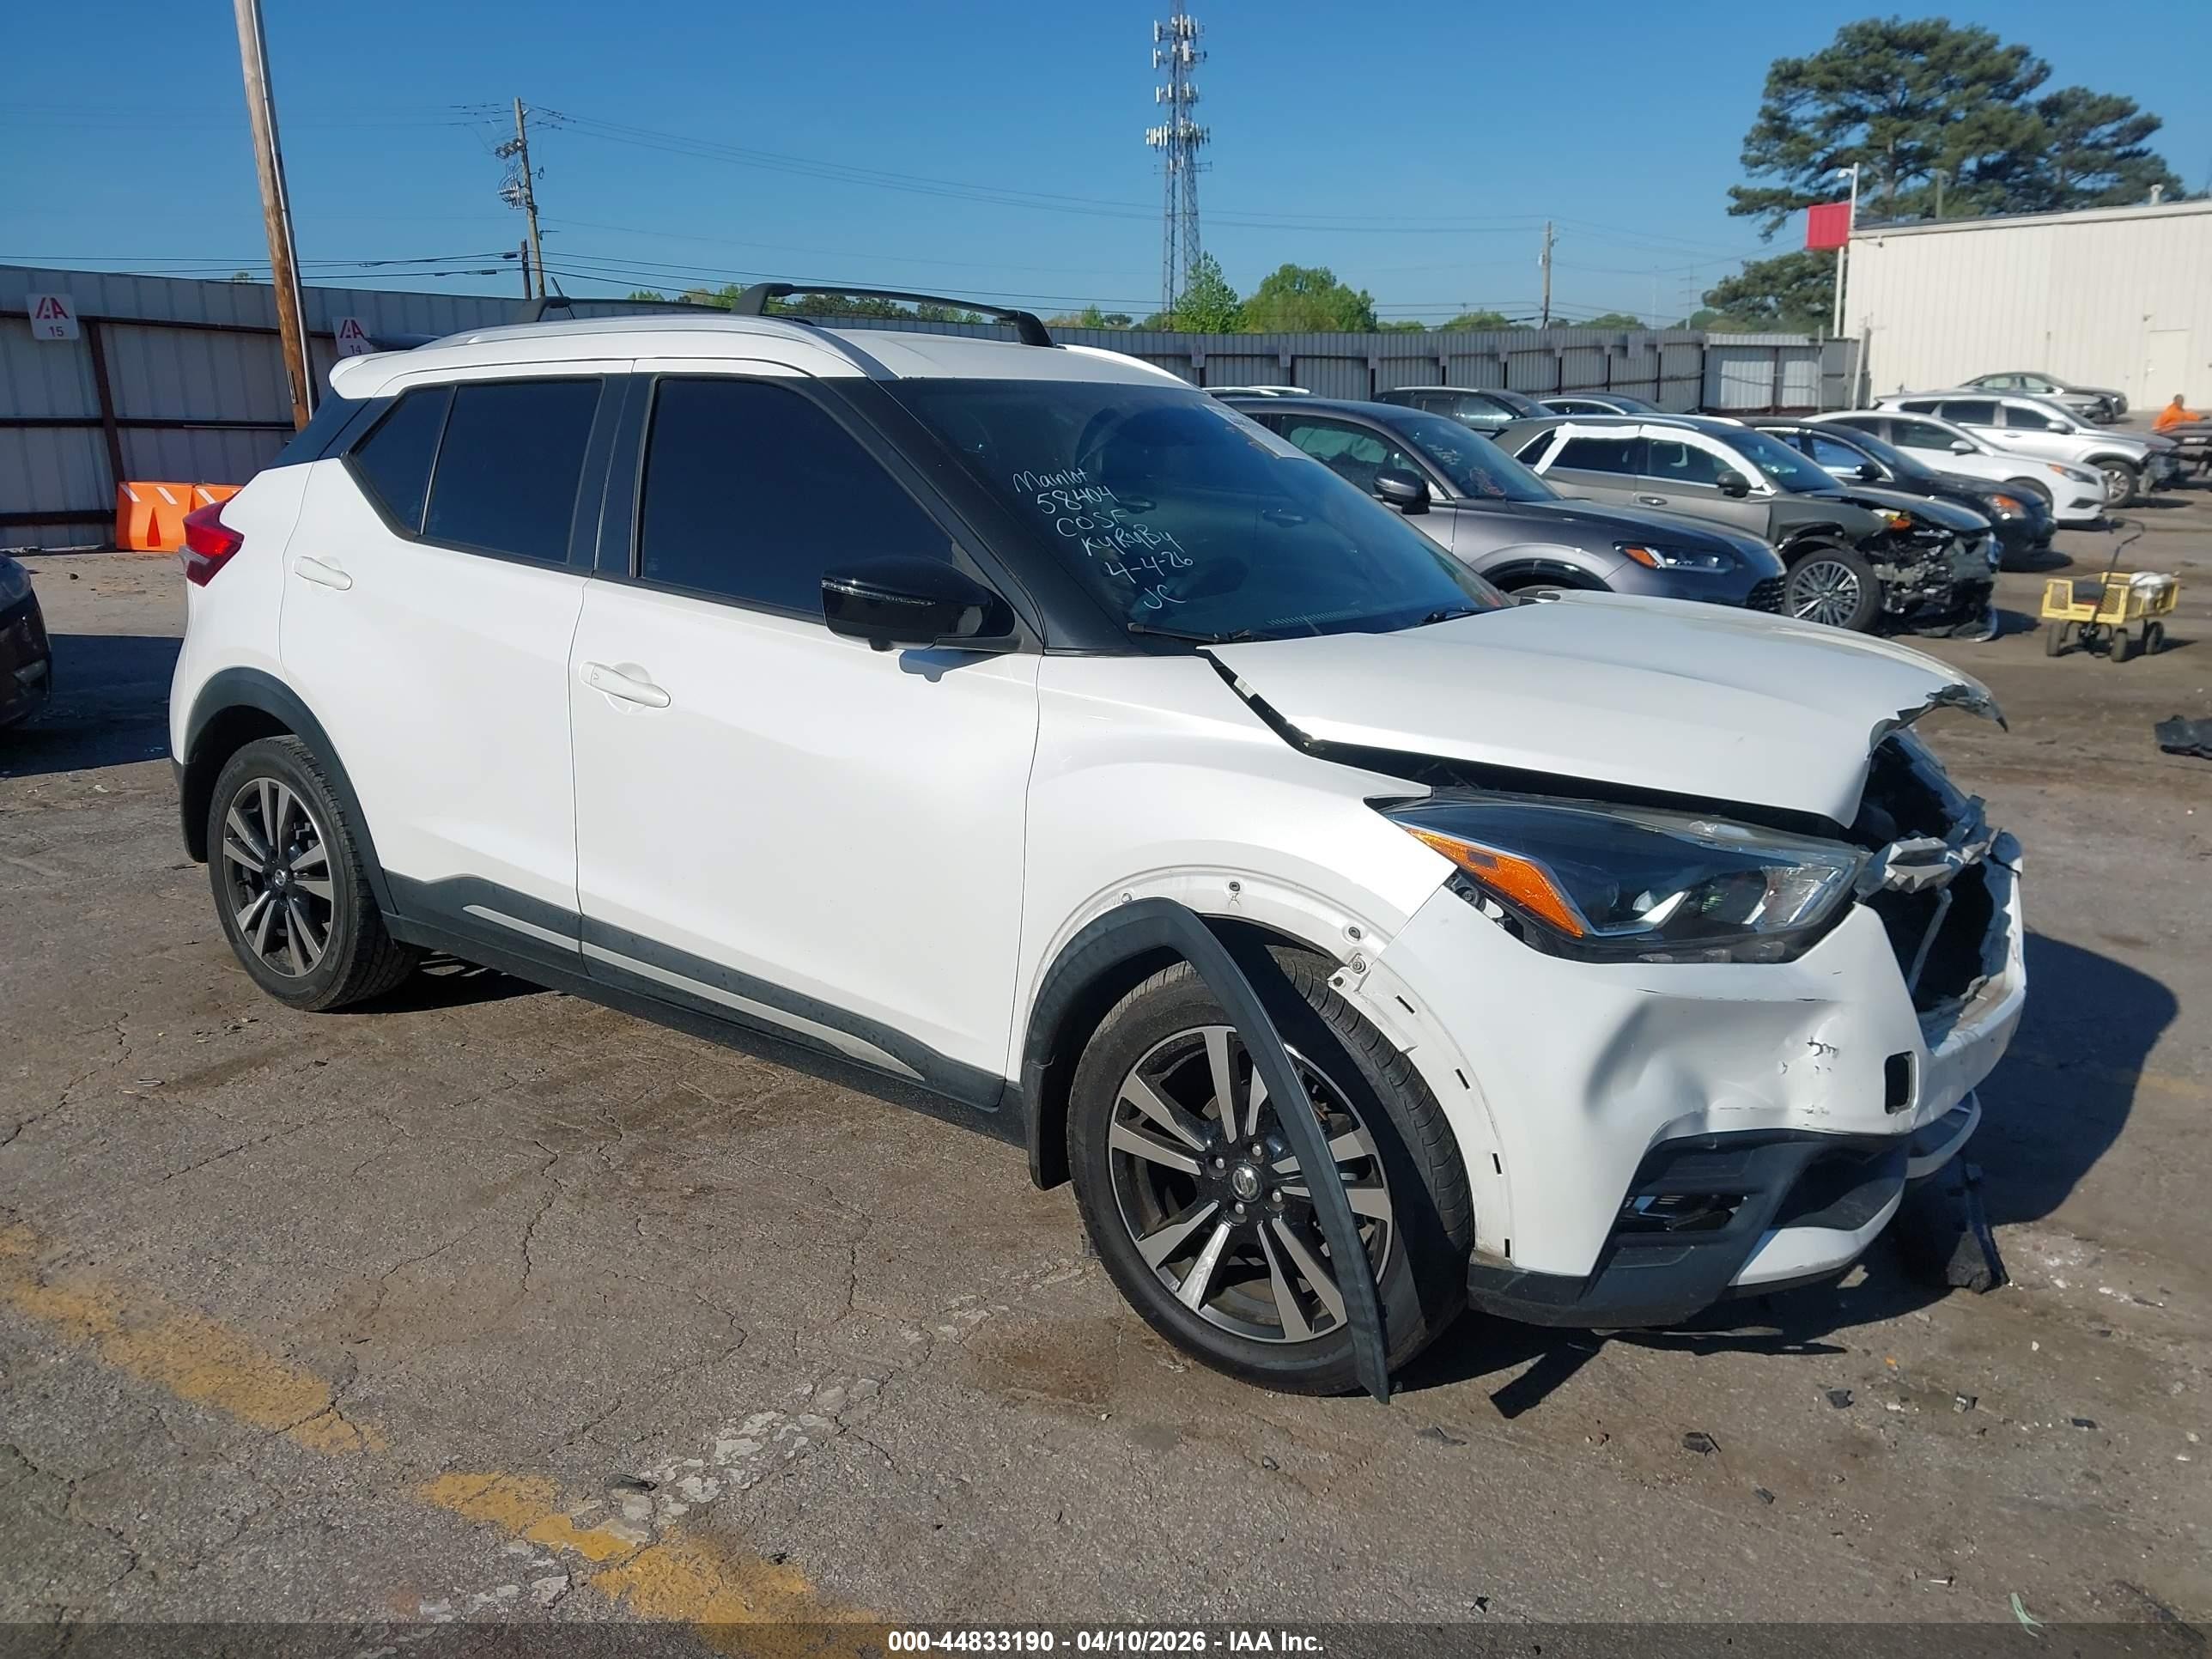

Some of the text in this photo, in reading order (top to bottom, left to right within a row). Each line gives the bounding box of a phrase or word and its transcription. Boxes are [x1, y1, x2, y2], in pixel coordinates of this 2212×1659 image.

[48, 325, 64, 337] 15
[1036, 485, 1120, 514] 58404
[1104, 551, 1194, 584] 4-4-26
[1143, 584, 1187, 610] JC
